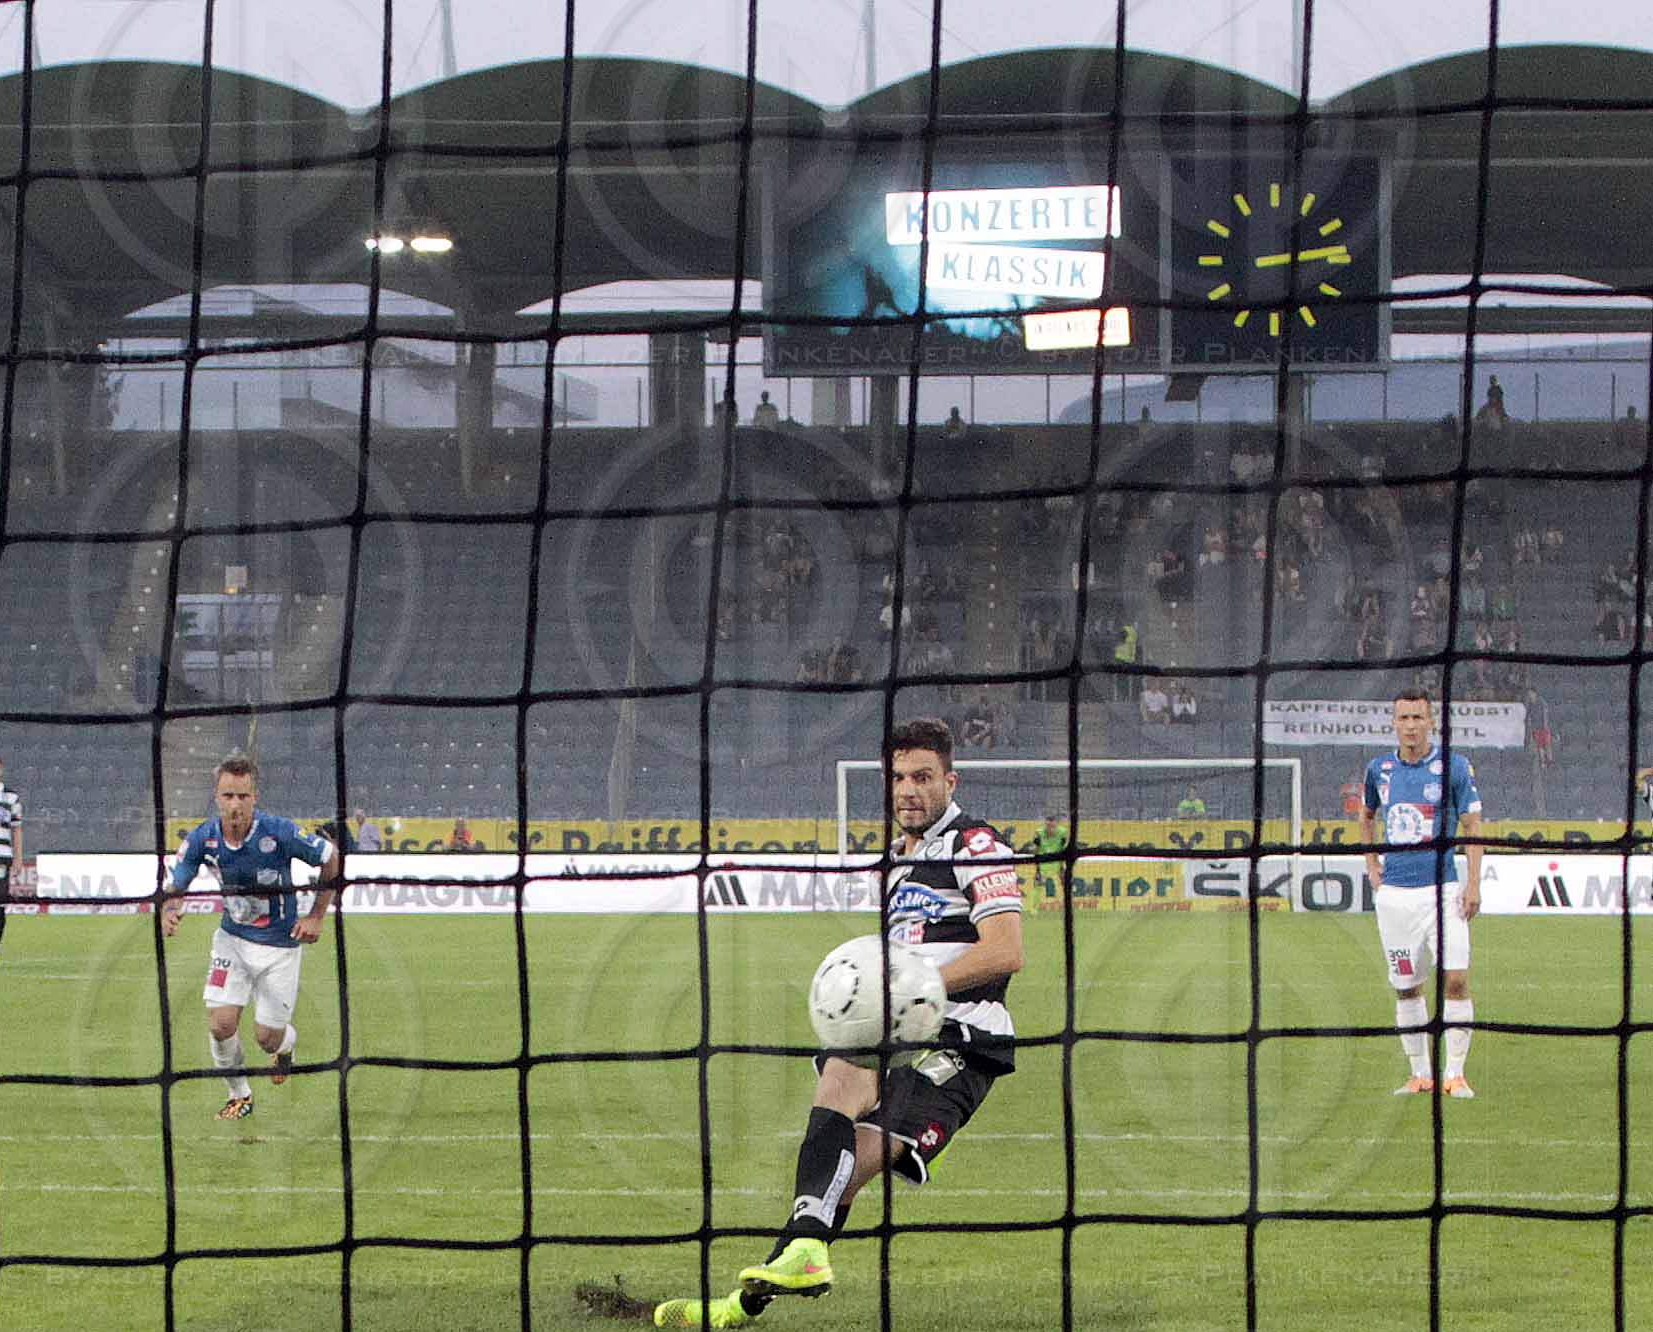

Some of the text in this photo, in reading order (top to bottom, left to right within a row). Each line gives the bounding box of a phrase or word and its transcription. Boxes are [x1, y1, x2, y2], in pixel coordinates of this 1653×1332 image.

[905, 197, 1099, 234] KONZERTE
[942, 253, 1087, 288] KLASSIK
[352, 875, 529, 907] MAGNA
[1193, 863, 1374, 911] ŠKO
